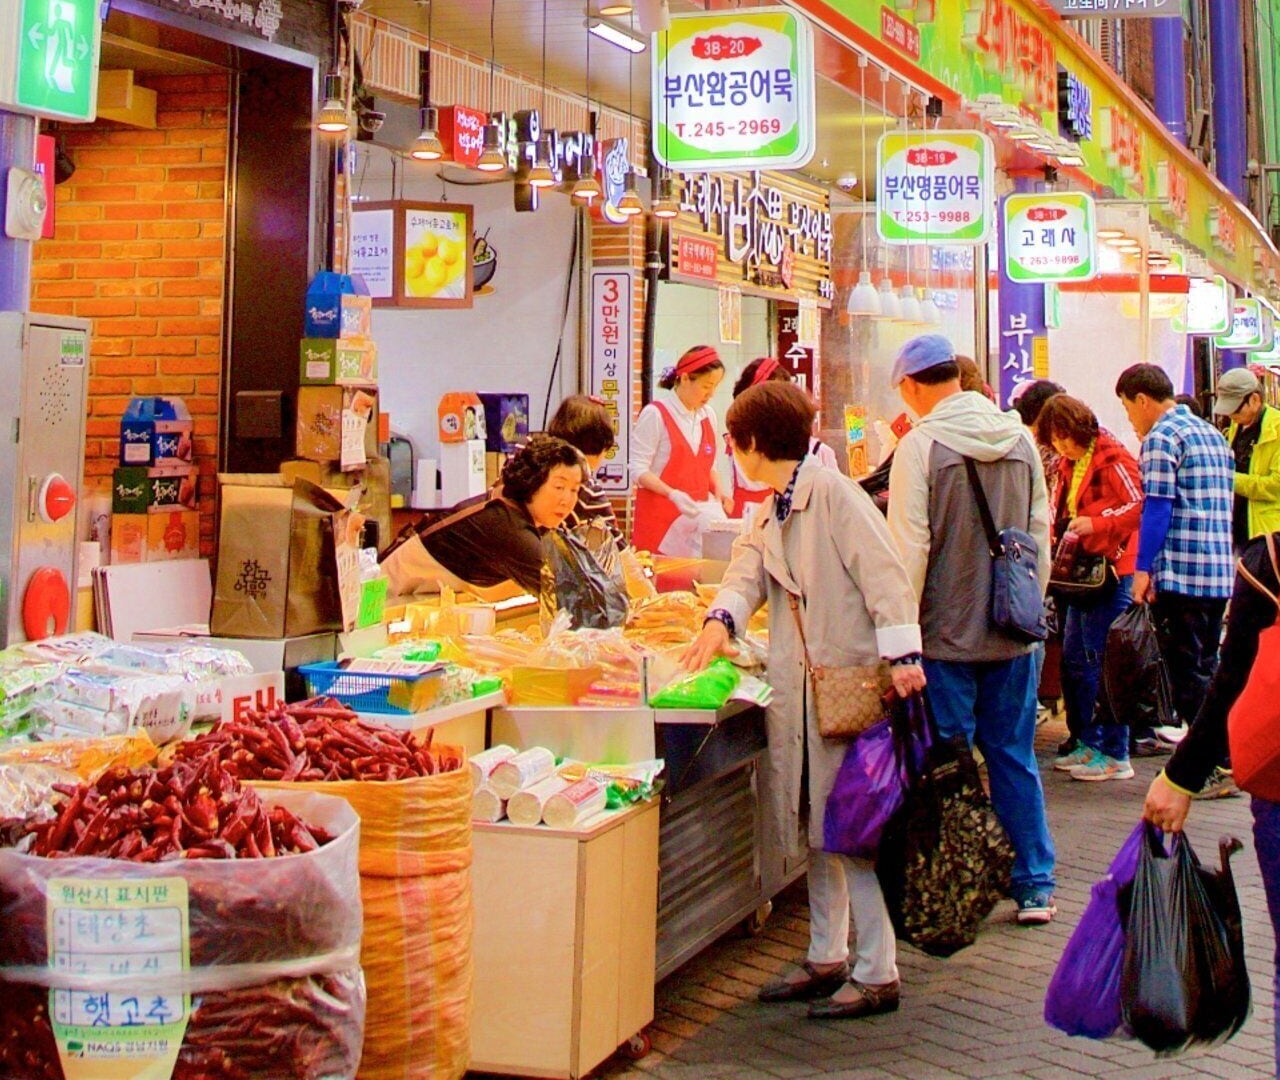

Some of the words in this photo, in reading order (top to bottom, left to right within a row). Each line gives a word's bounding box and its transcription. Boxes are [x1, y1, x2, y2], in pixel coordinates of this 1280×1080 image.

[703, 40, 745, 56] 3B-20
[675, 118, 781, 138] T.245-2969
[885, 175, 980, 201] 부산명품어묵
[893, 211, 970, 223] T.253-9988
[1022, 227, 1076, 248] 고래사
[601, 278, 620, 345] 3만원
[603, 348, 617, 377] 이상
[62, 884, 108, 904] 원산지
[119, 884, 169, 903] 표시판
[76, 912, 155, 944] 태양초
[83, 993, 173, 1028] 햇고추
